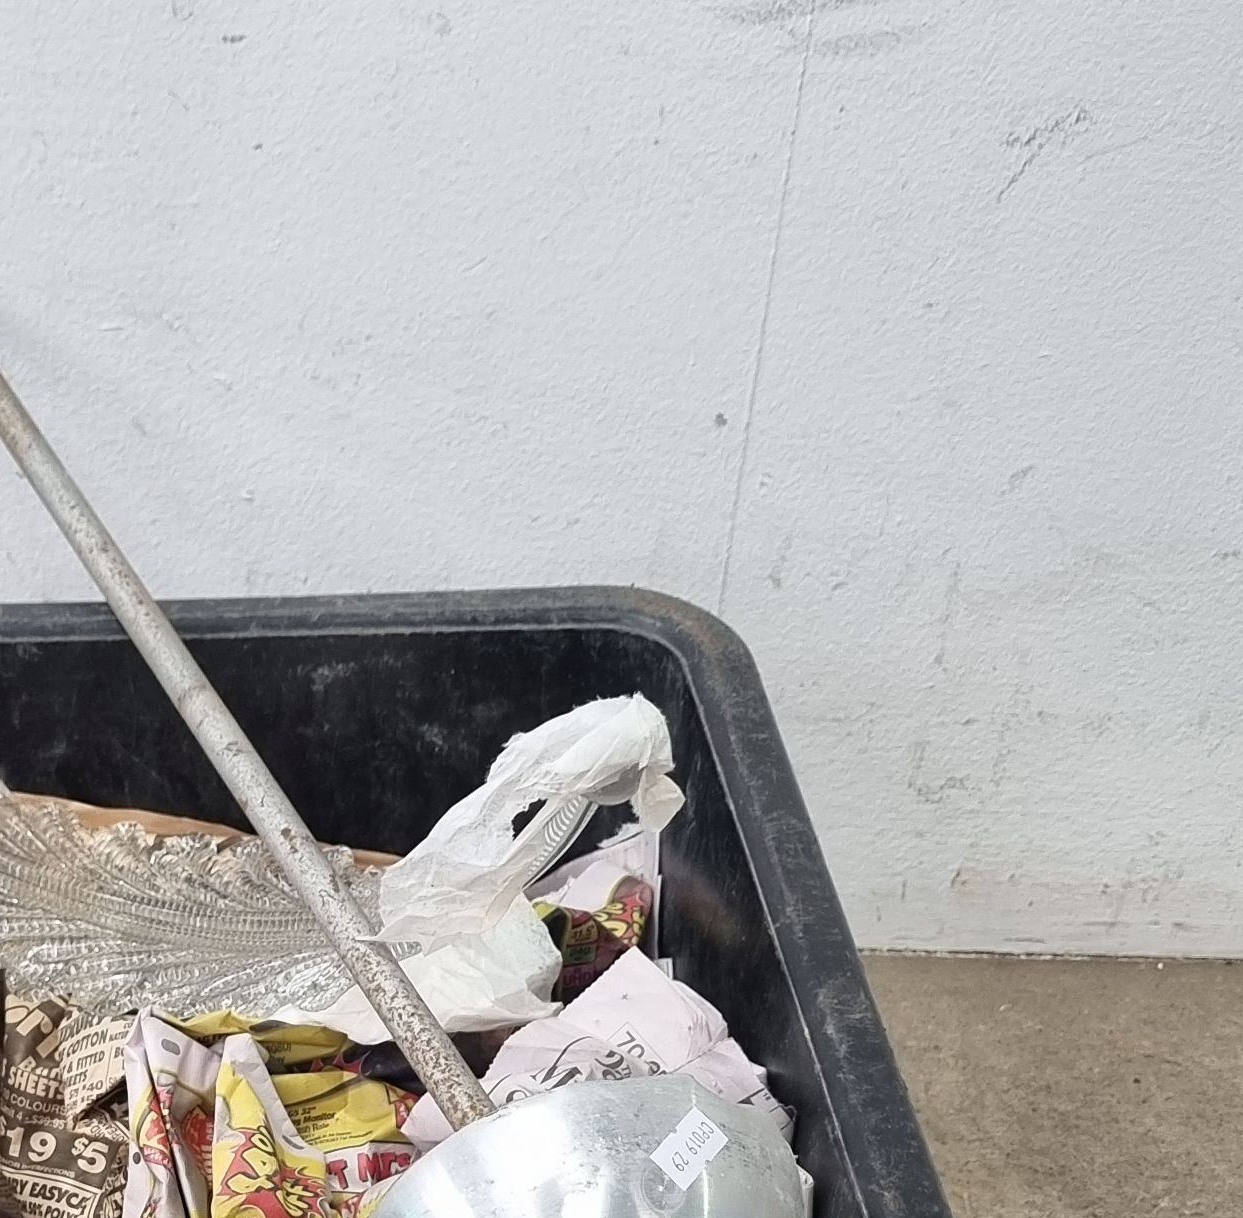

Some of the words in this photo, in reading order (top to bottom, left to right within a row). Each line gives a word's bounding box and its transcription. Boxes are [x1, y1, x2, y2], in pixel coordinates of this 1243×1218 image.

[66, 1028, 109, 1060] COTTON
[10, 1093, 68, 1116] COLOURS
[684, 1120, 716, 1156] CP019
[71, 1136, 109, 1174] $5
[671, 1150, 691, 1173] 29
